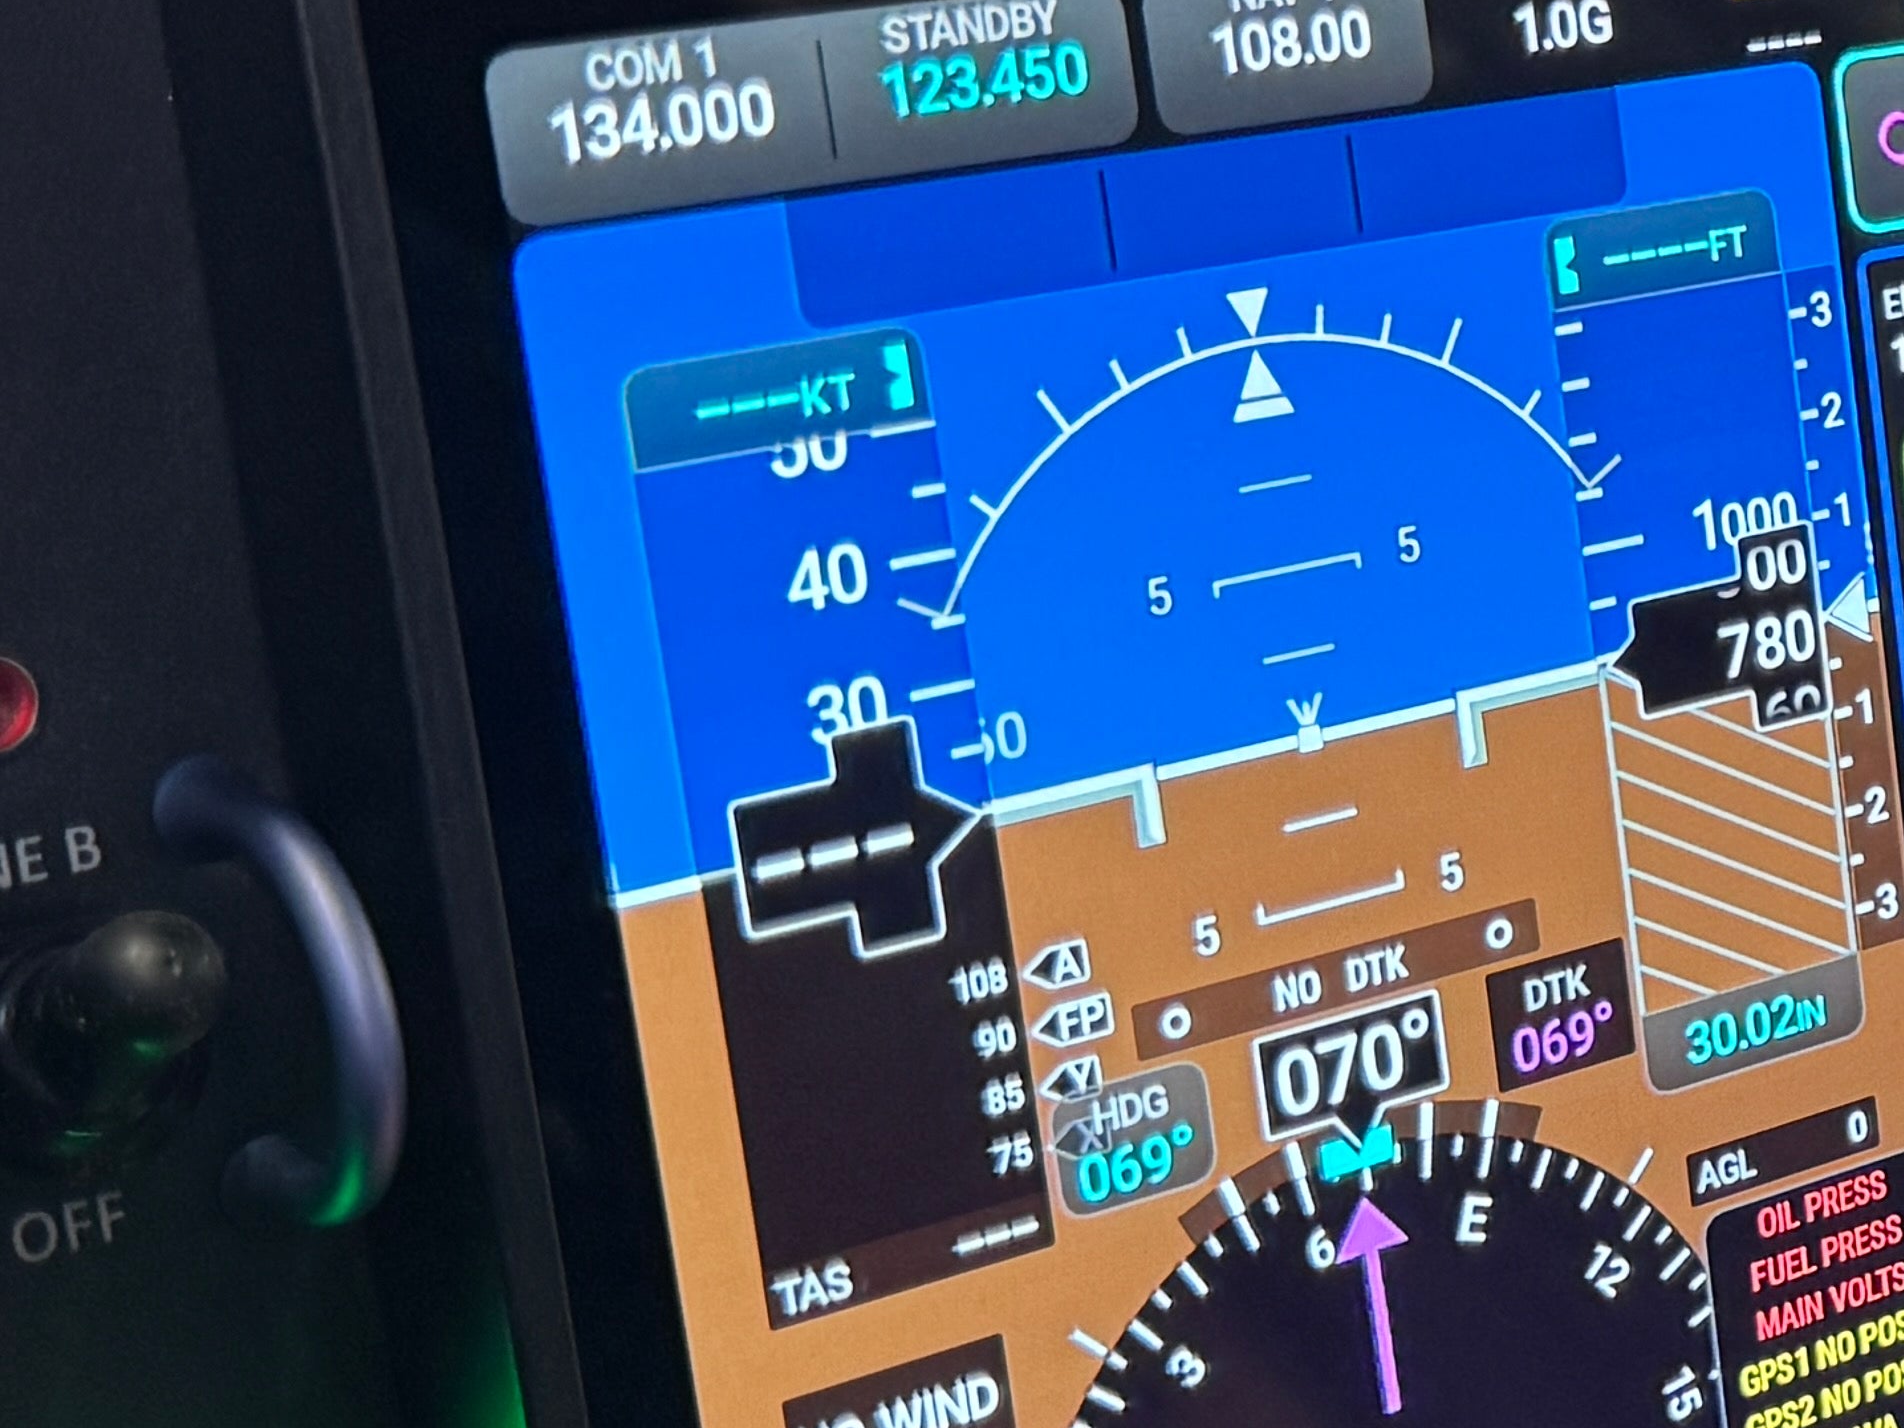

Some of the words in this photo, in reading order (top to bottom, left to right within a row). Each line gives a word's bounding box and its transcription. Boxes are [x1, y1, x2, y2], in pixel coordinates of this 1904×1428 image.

[1212, 10, 1373, 80] 108.00
[1511, 1, 1614, 53] 1.0G
[586, 44, 683, 91] COM
[695, 37, 718, 78] 1
[877, 39, 1090, 121] 123.450
[549, 78, 776, 165] 134.000
[787, 543, 867, 610] 40
[1717, 608, 1815, 680] 780
[65, 826, 102, 873] B
[1272, 967, 1320, 1012] NO
[1347, 946, 1409, 993] DTK
[1522, 965, 1591, 1009] DTK
[972, 1024, 1016, 1060] 90
[1512, 1000, 1614, 1073] 069°
[1684, 993, 1826, 1065] 30.02IN
[1272, 1007, 1431, 1118] 070°
[981, 1076, 1025, 1118] 85
[1093, 1085, 1170, 1135] HDG
[987, 1137, 1034, 1176] 75
[1077, 1123, 1193, 1204] 069°
[1697, 1150, 1756, 1193] AGL
[1847, 1112, 1869, 1143] 0
[12, 1192, 126, 1262] OFF
[1758, 1203, 1799, 1238] OIL
[1803, 1171, 1888, 1223] PRESS
[1582, 1246, 1630, 1296] 12
[1751, 1250, 1818, 1292] FUEL
[1822, 1215, 1903, 1268] PRESS
[770, 1260, 854, 1316] TAS
[1755, 1296, 1825, 1341] MAIN
[1739, 1346, 1809, 1398] GPS1
[1816, 1334, 1855, 1370] NO
[1821, 1379, 1861, 1419] NO
